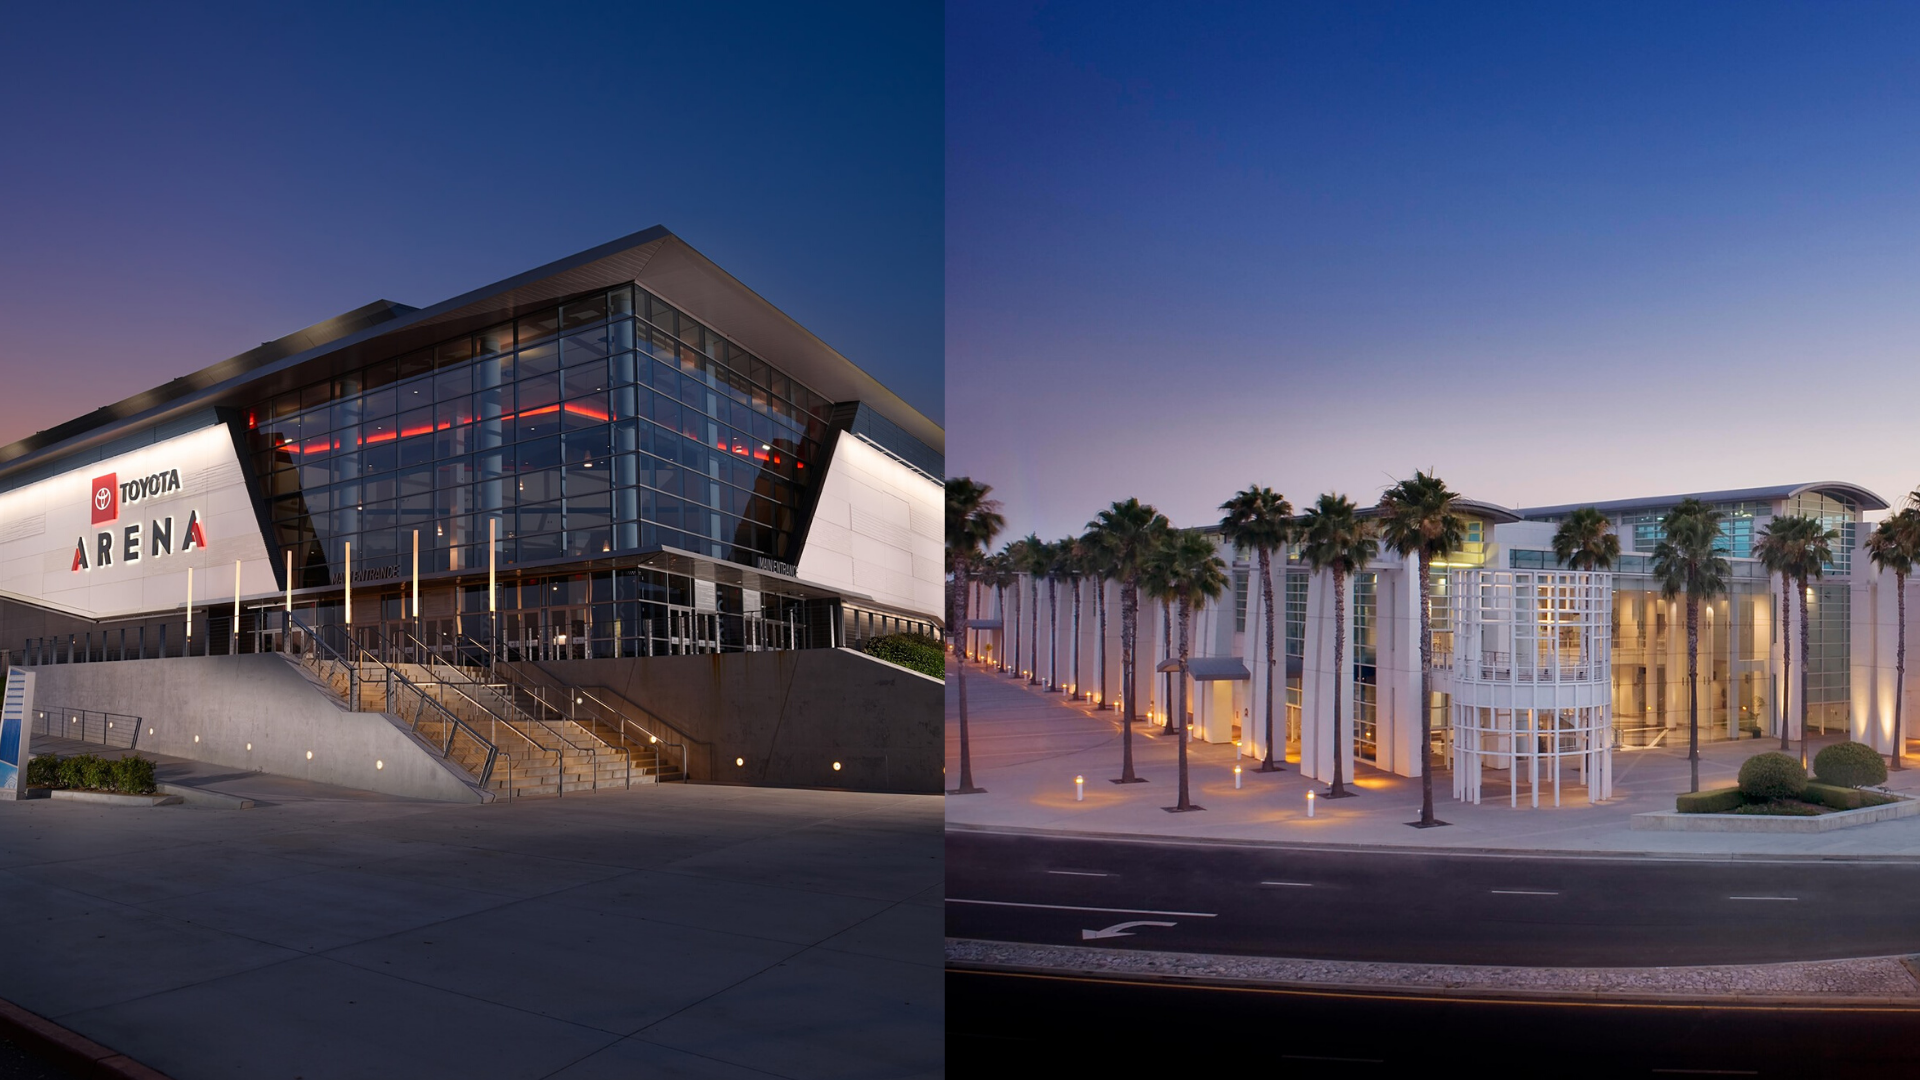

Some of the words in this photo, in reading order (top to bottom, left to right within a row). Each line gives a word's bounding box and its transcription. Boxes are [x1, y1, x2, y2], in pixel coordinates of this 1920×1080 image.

[119, 468, 181, 503] TOYOTA
[71, 510, 206, 571] ARENA
[353, 565, 401, 583] ENTRANCE
